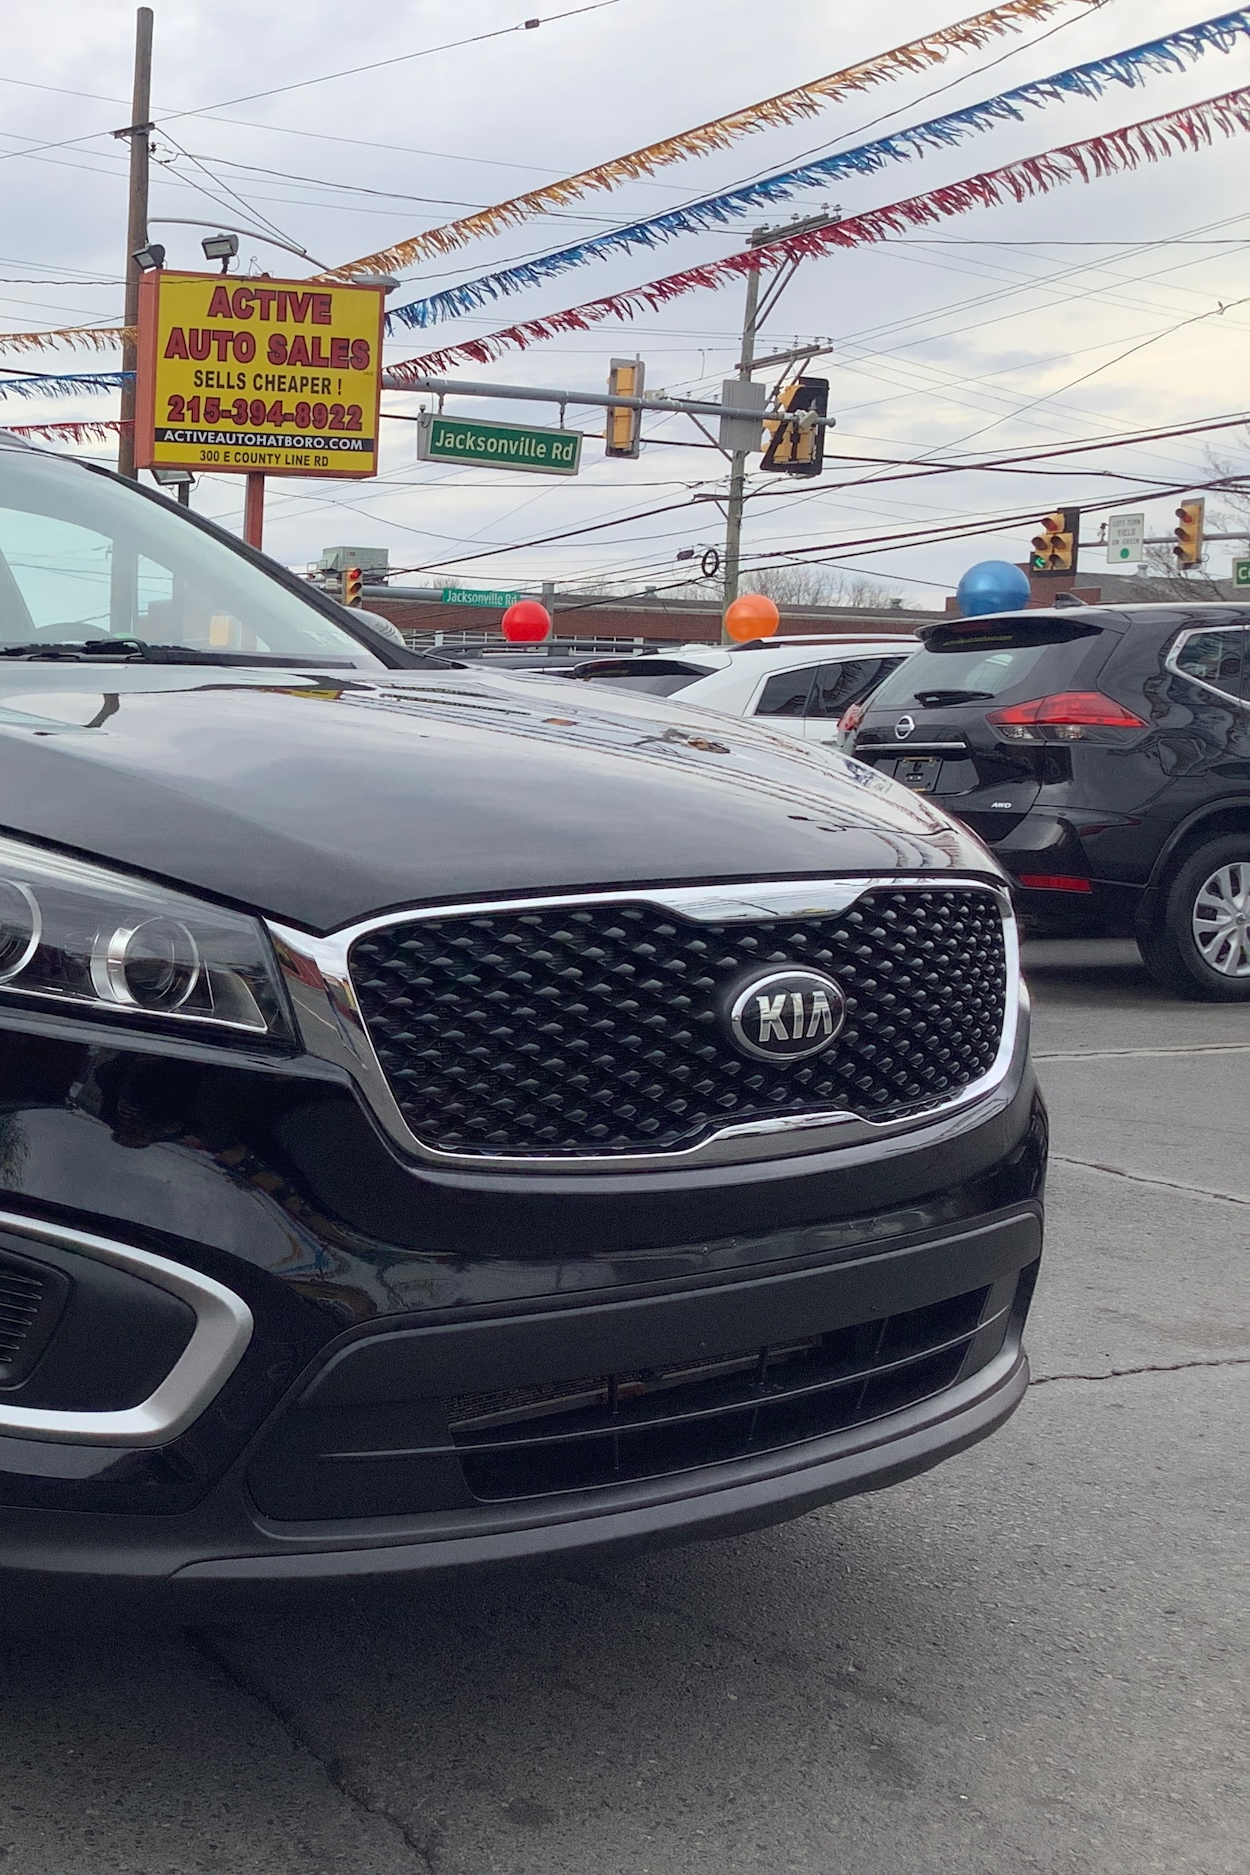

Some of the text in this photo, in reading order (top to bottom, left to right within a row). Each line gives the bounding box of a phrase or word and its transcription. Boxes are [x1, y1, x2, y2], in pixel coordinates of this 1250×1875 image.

[207, 286, 333, 325] ACTIVE
[164, 326, 371, 371] AUTO SALES
[193, 369, 247, 391] SELLS
[253, 374, 332, 395] CHEAPER
[166, 394, 363, 431] 215-394-8922
[163, 429, 363, 450] ACTIVEAUTOHATBORO.COM
[435, 429, 574, 461] Jacksonville Rd
[199, 450, 329, 467] 300 E COUNTY LINE RD
[446, 590, 518, 606] Jacksonville Rd
[756, 990, 833, 1042] KIA
